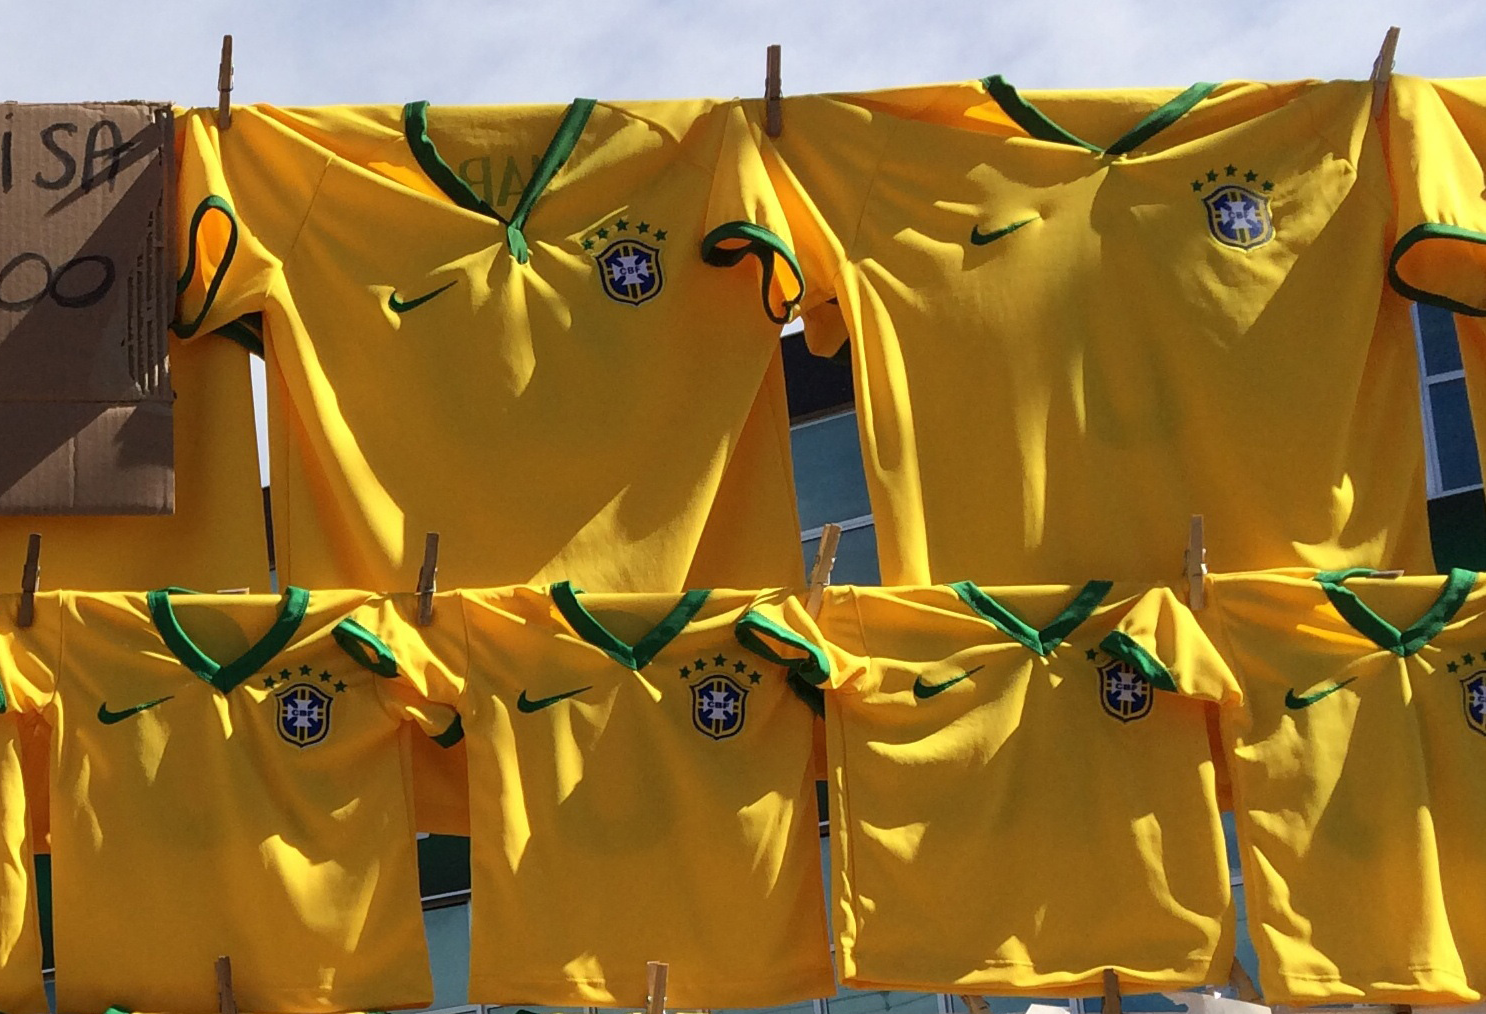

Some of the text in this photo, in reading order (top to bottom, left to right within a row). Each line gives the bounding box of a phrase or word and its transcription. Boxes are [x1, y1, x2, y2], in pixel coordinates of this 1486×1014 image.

[619, 265, 641, 276] CBF
[707, 700, 730, 709] CBF
[291, 709, 315, 717] CBF
